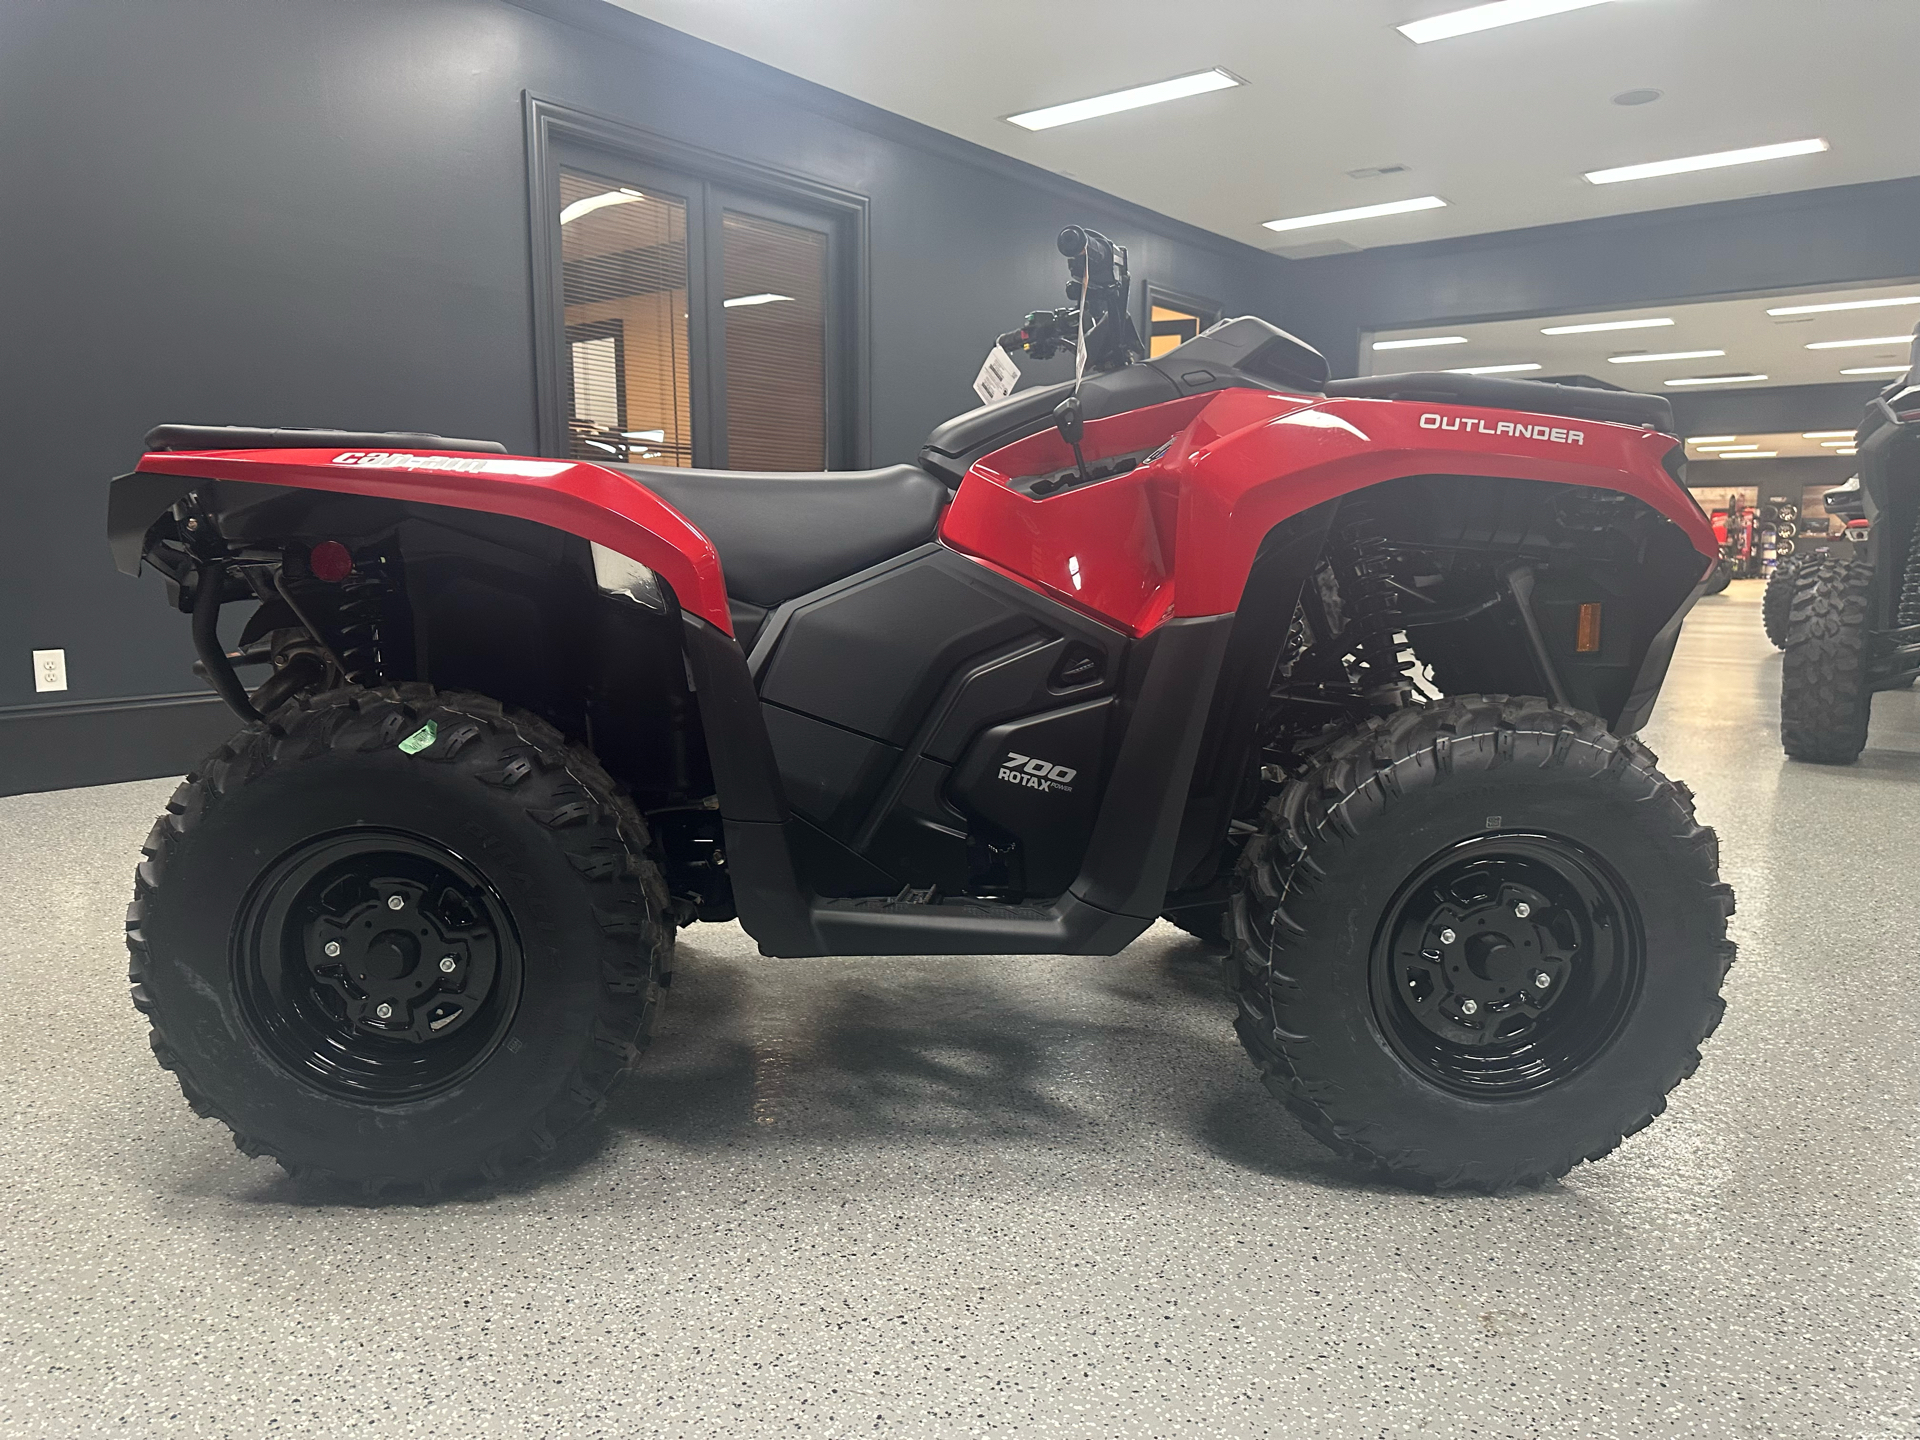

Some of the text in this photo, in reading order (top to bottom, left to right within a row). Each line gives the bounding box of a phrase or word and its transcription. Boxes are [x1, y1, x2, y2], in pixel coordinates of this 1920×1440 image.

[1419, 413, 1584, 445] OUTLANDER
[332, 452, 487, 473] can-am
[998, 768, 1073, 793] ROTAX POWER
[1002, 752, 1077, 783] 700
